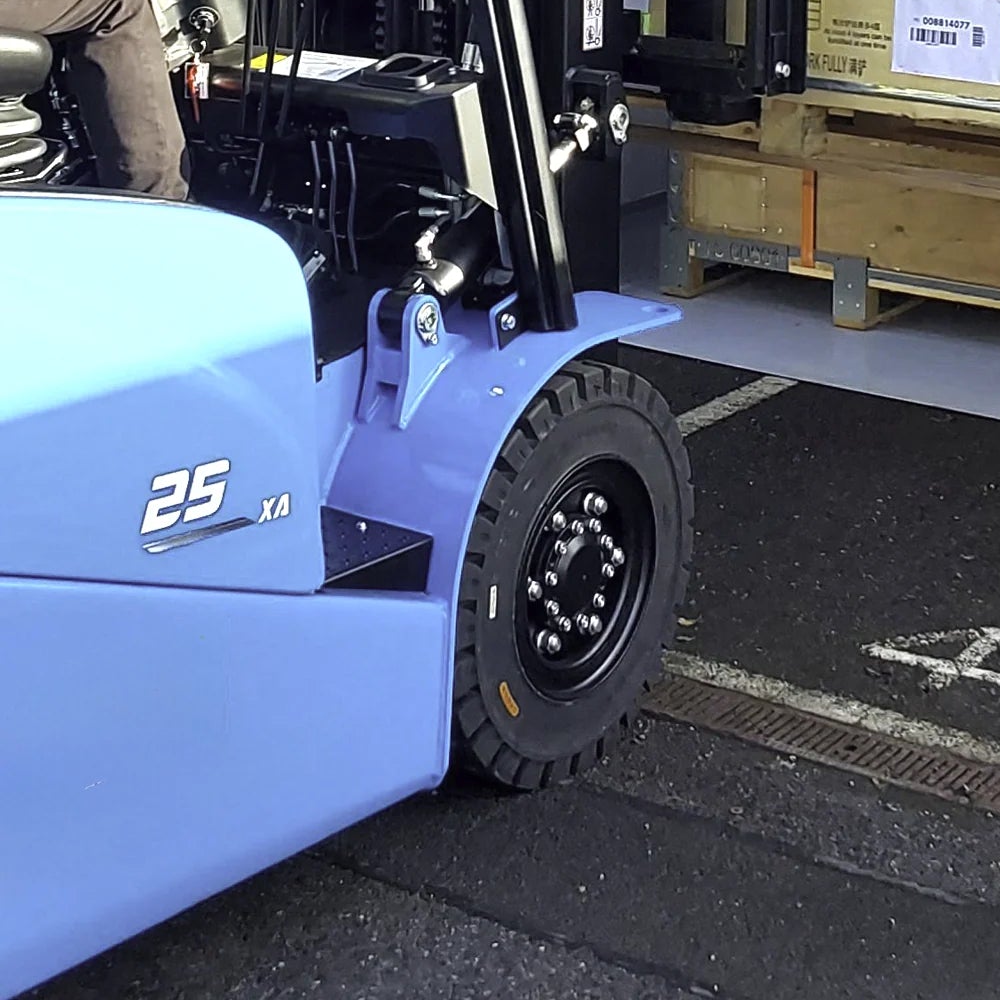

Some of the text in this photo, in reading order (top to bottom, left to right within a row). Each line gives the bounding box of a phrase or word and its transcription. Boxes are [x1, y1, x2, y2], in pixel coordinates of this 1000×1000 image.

[922, 16, 971, 30] 008814077
[822, 53, 848, 74] FULLY
[140, 458, 292, 535] 25 XA
